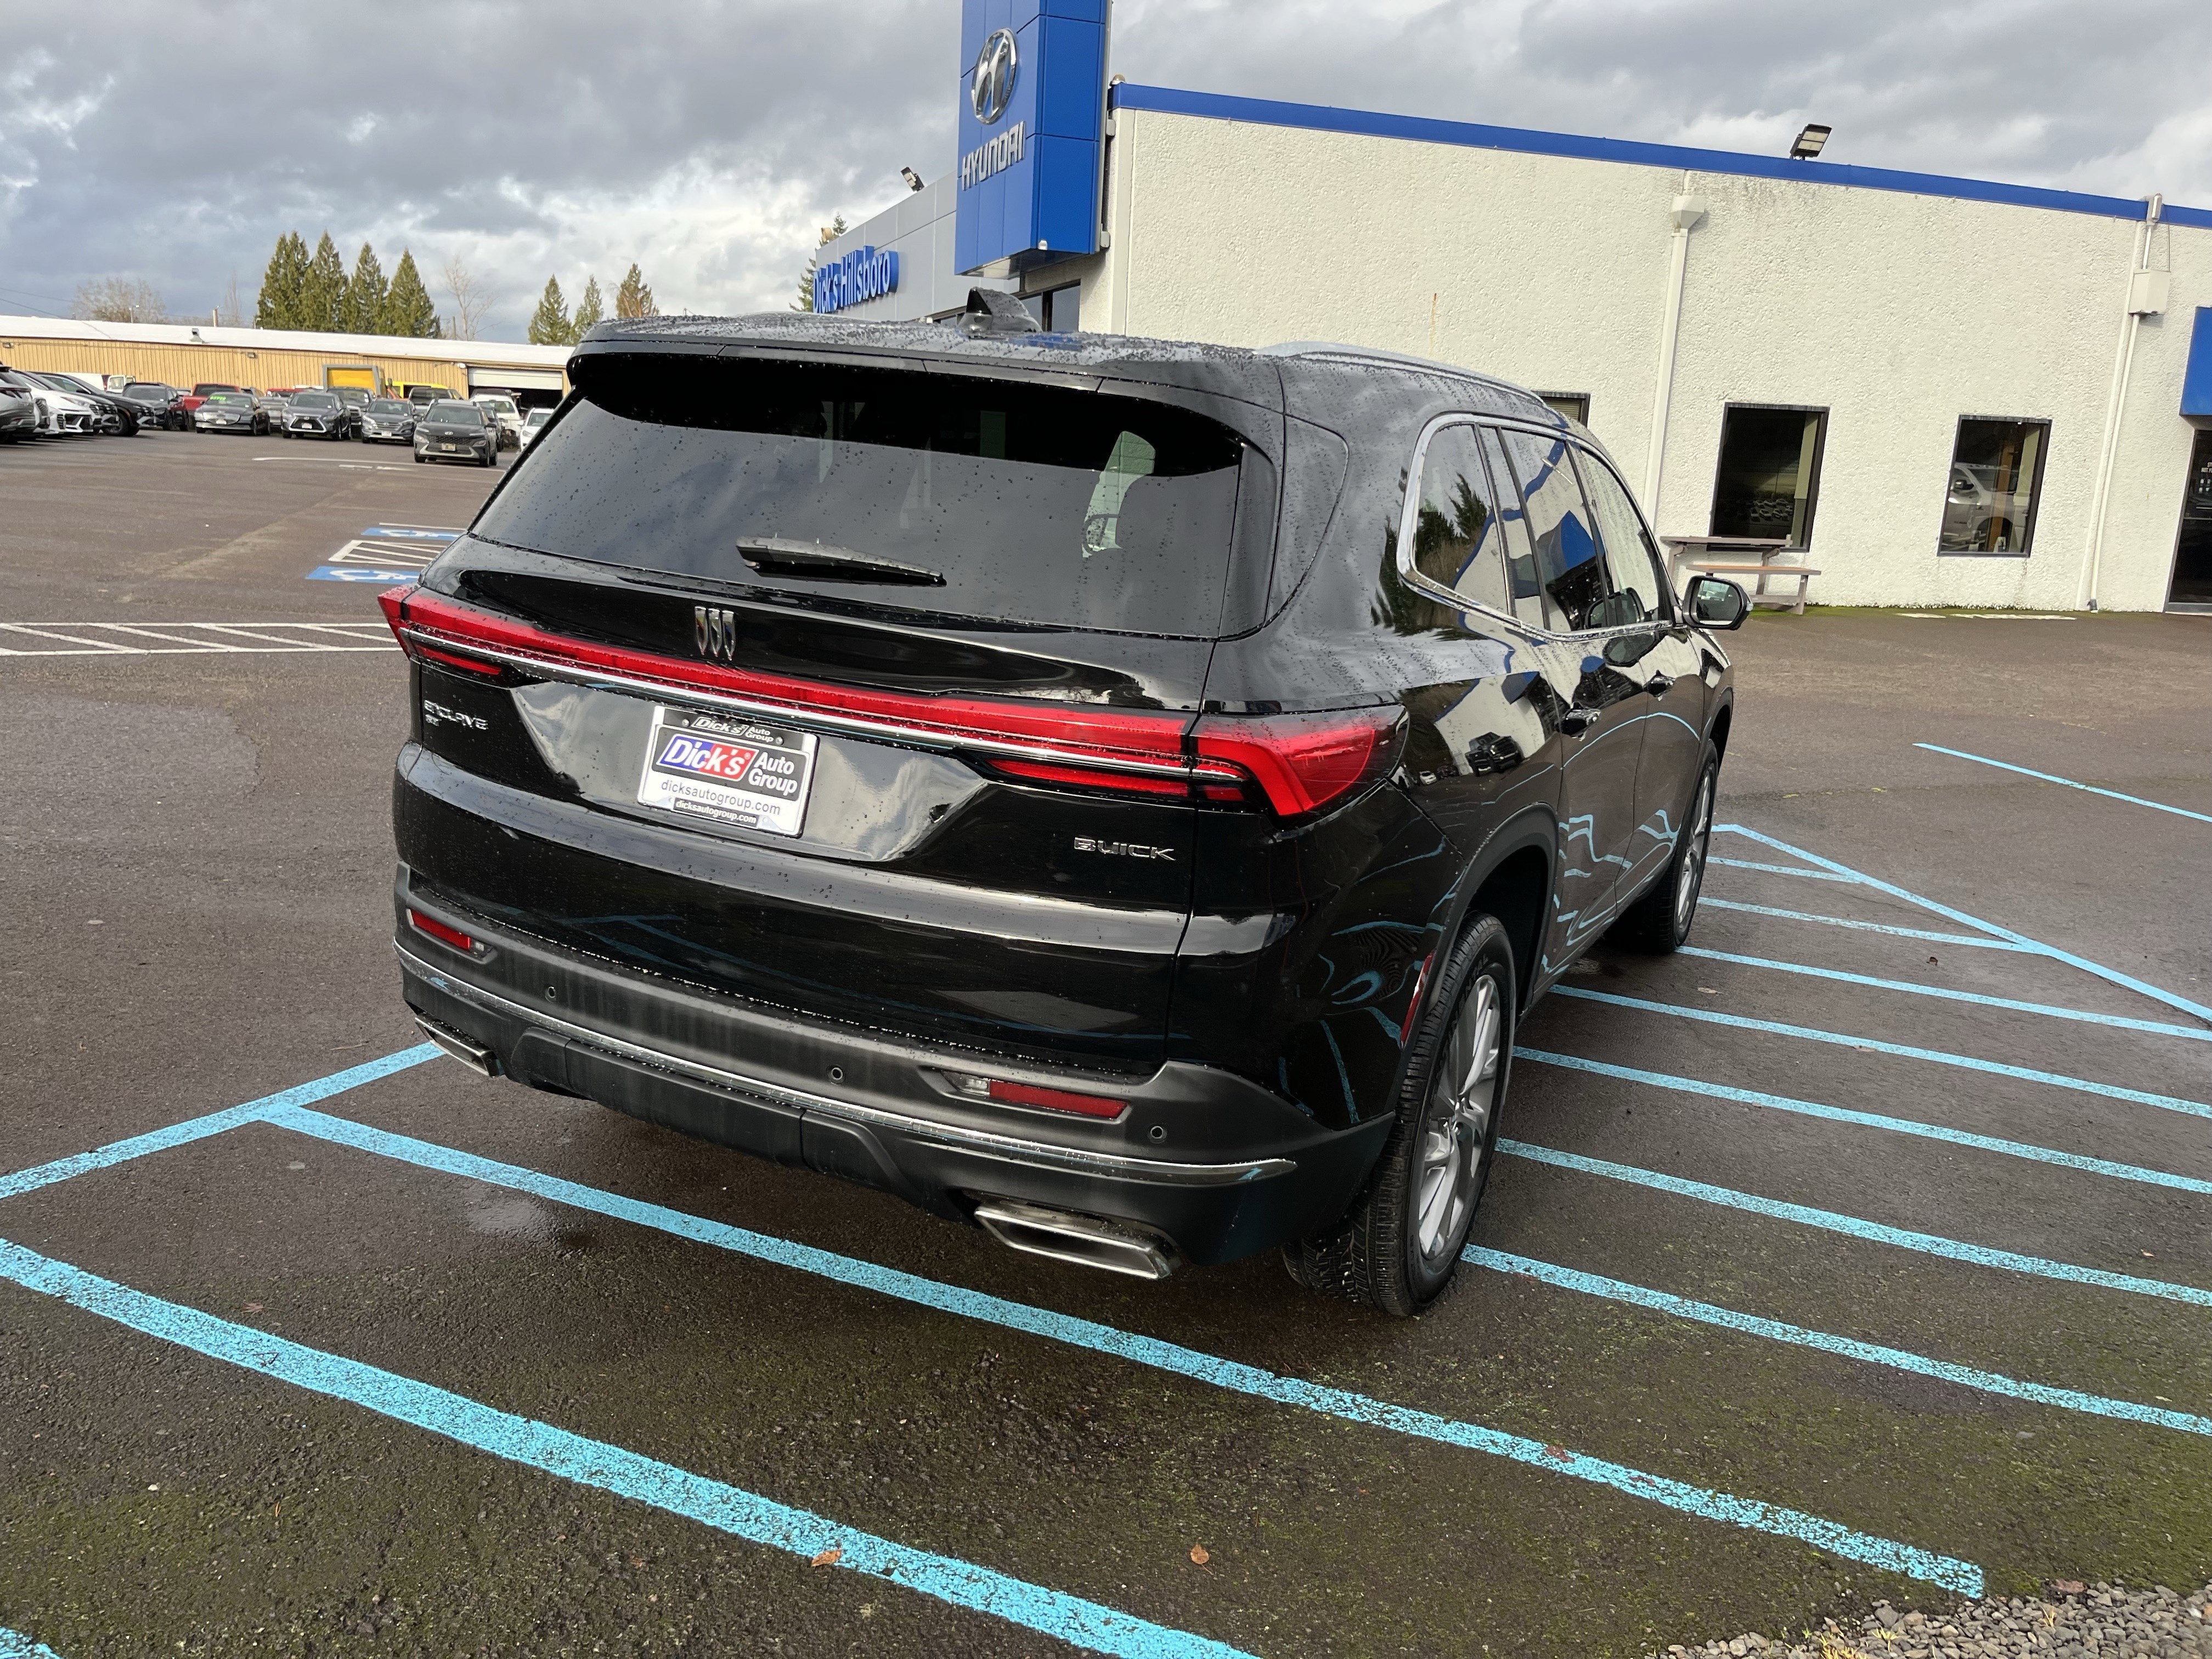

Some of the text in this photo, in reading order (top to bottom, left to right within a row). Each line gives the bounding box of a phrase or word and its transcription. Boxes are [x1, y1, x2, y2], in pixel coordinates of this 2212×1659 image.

[962, 120, 1025, 191] HYUNDAI
[813, 246, 893, 314] Dick's Hillsboro
[695, 718, 743, 734] Dick's
[744, 731, 774, 743] Group
[747, 726, 771, 736] Auto
[664, 738, 746, 776] Dick's
[754, 752, 795, 775] Auto
[748, 768, 798, 796] Group
[661, 780, 781, 815] dicksautogroup.com
[676, 799, 757, 824] dicksautogroup.com
[1074, 837, 1176, 861] BUICK
